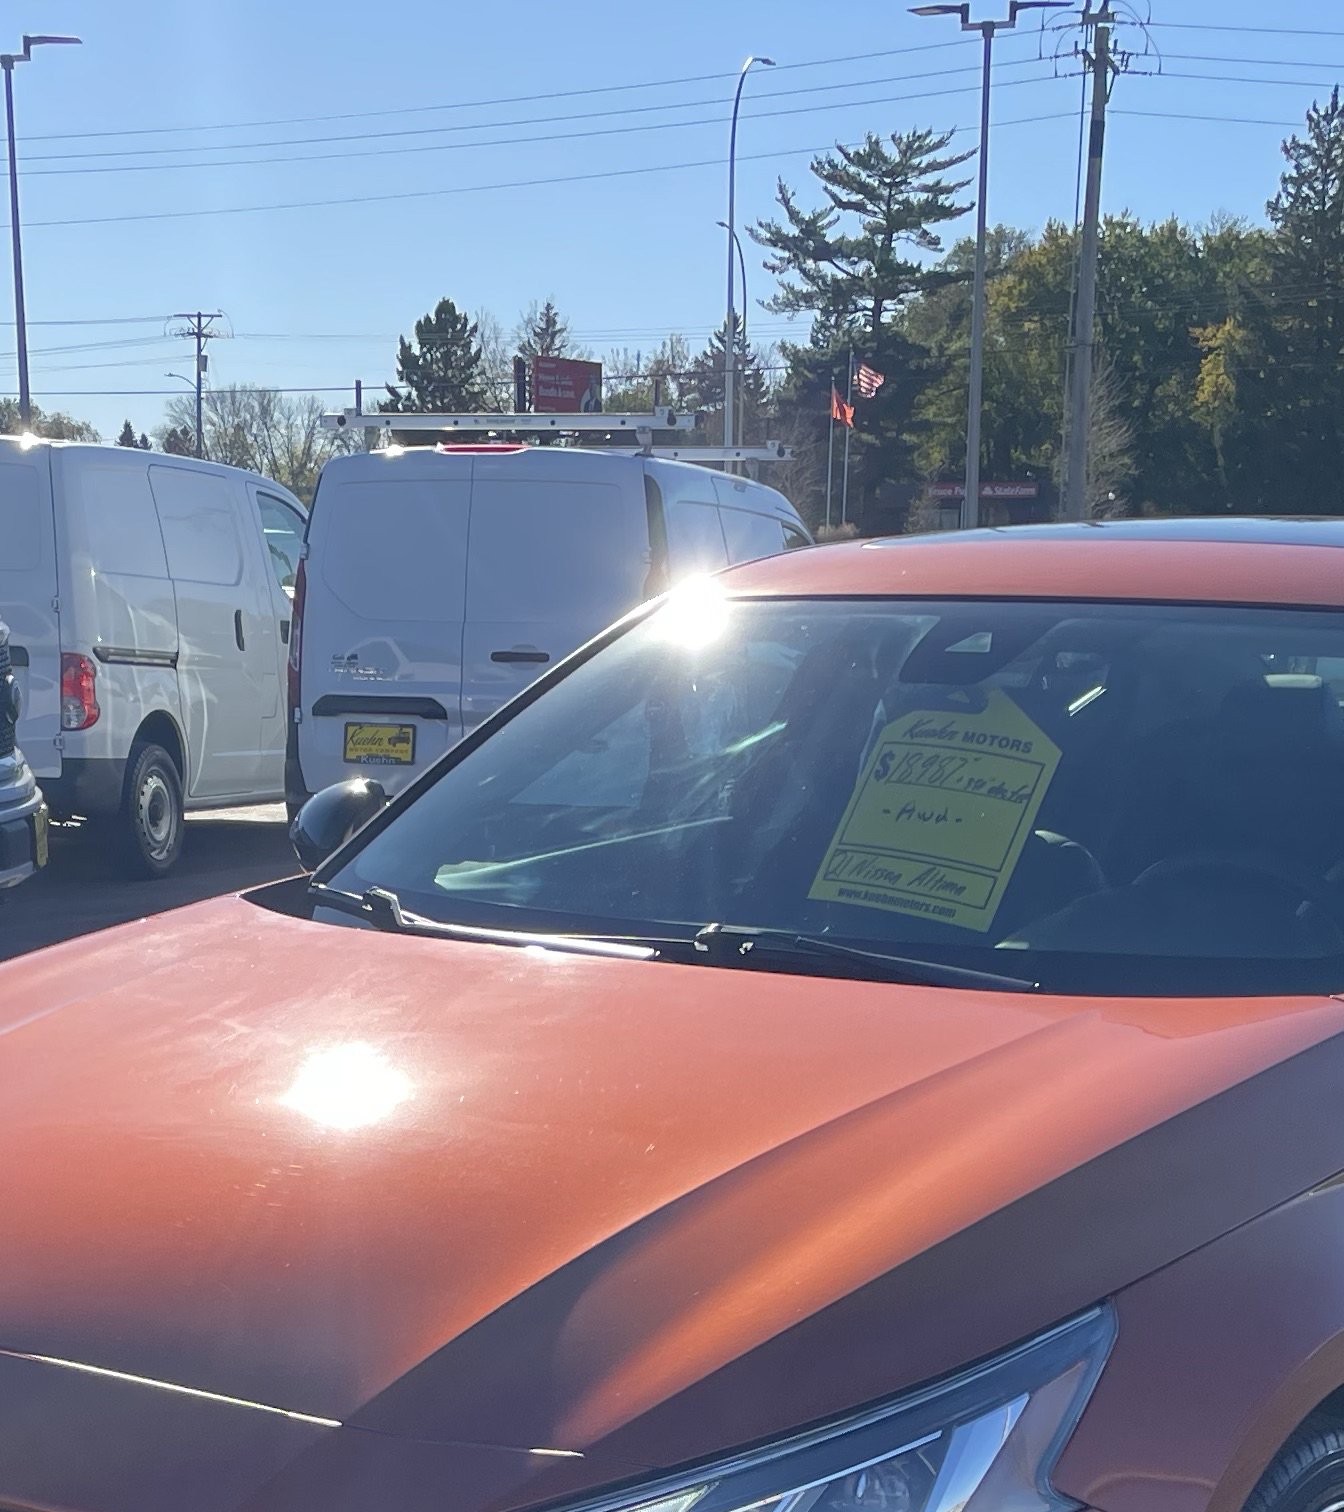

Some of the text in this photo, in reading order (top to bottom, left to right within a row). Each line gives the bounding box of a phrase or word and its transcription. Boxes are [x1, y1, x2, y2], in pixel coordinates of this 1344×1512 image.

[347, 727, 385, 747] Kuehn
[961, 730, 1035, 754] MOTORS
[360, 755, 396, 765] Kuehn
